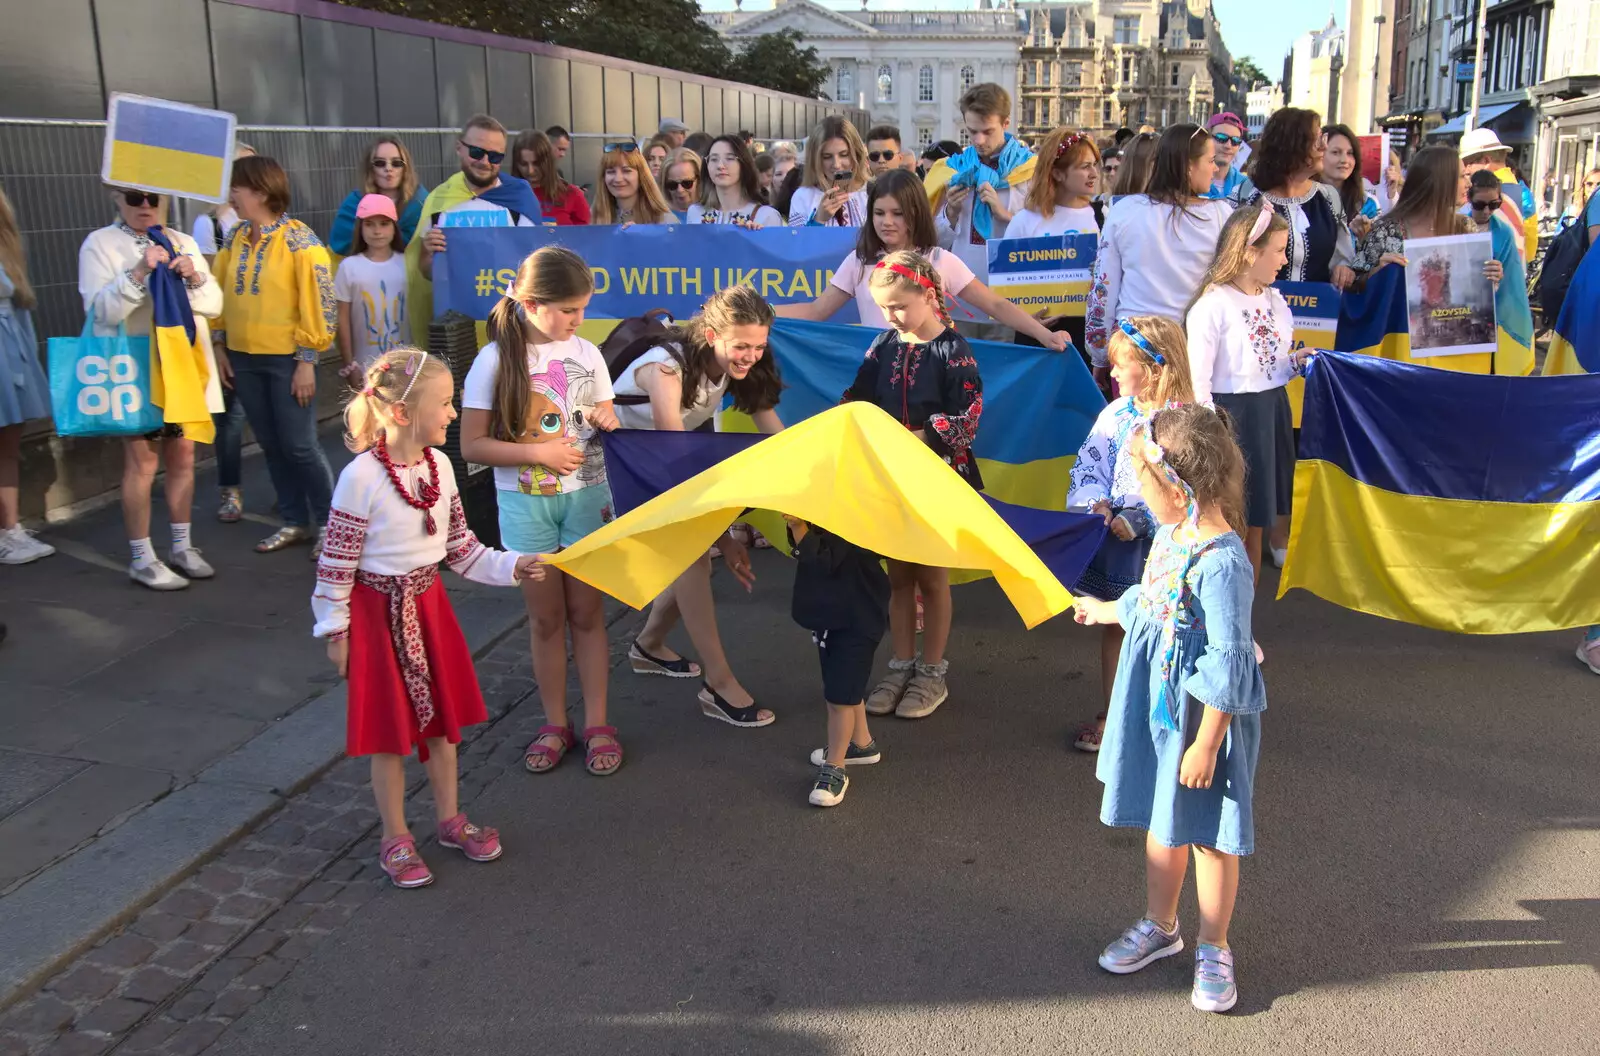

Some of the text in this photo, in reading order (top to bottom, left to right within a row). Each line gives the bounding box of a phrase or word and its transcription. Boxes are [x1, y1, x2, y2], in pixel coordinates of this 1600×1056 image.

[1008, 248, 1077, 263] STUNNING
[475, 267, 835, 297] #SD WITH UKRAI
[1285, 294, 1318, 308] TIVE
[1431, 307, 1472, 317] AZOVSTAL
